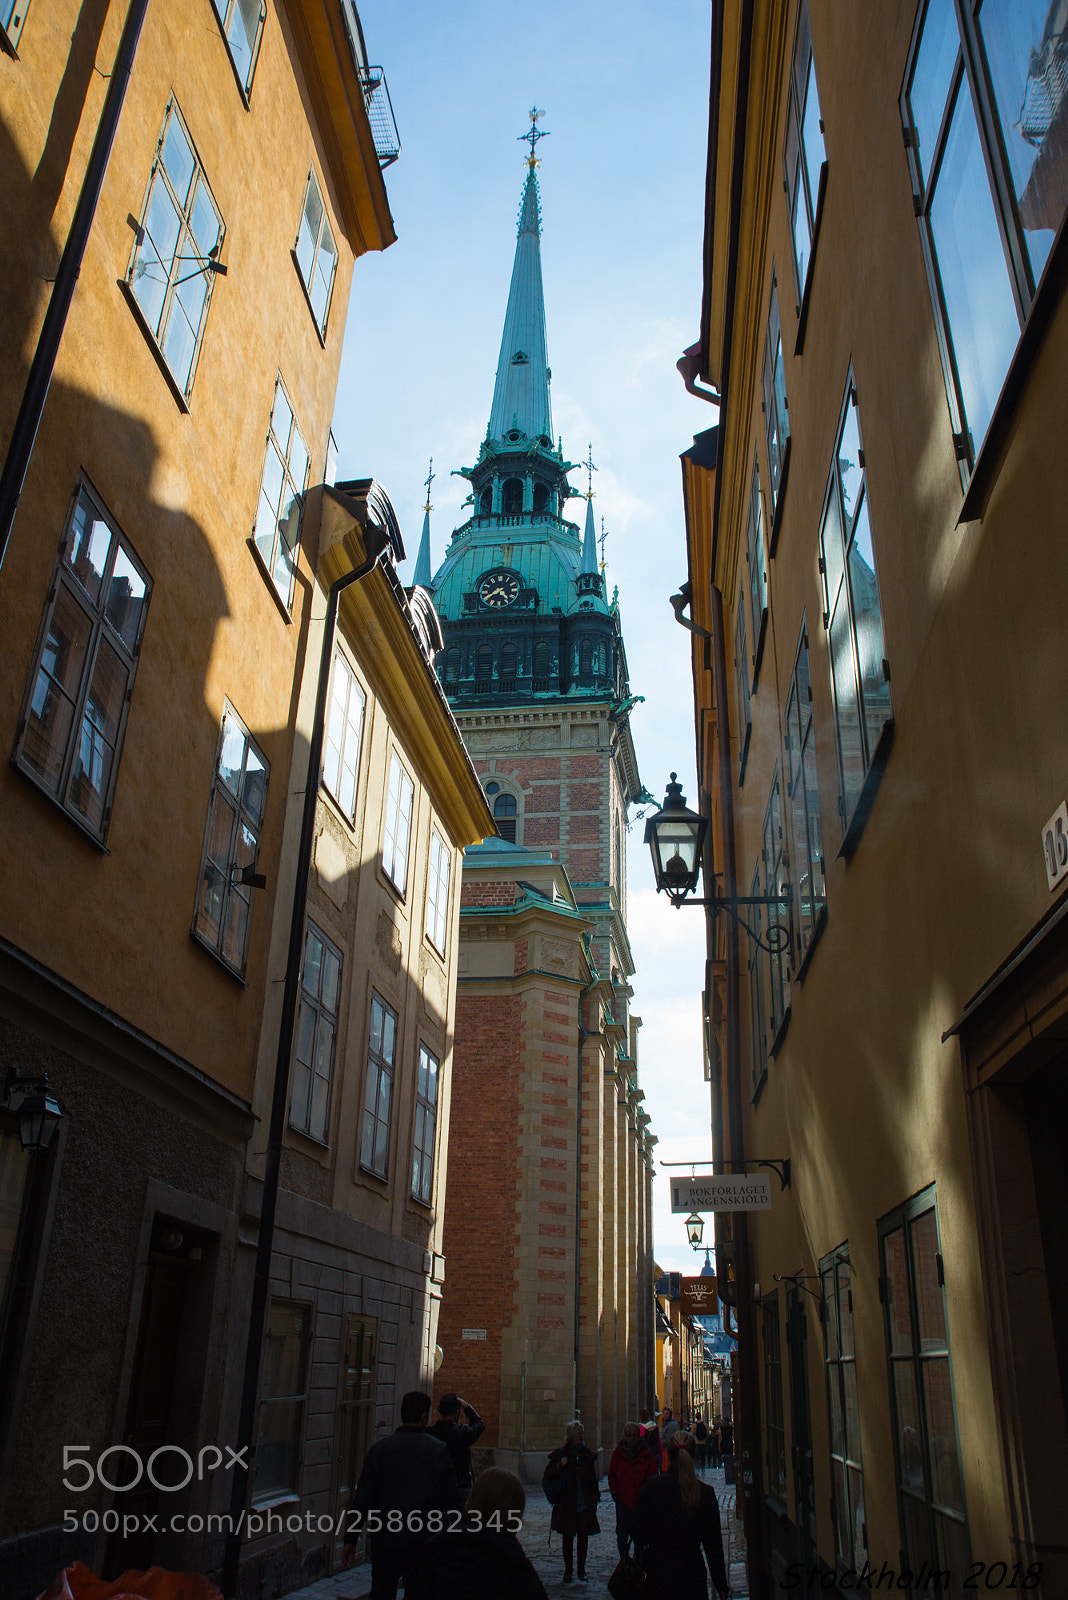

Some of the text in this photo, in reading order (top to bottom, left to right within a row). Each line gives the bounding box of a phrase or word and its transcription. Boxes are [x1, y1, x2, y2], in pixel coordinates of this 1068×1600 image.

[1046, 818, 1068, 876] 16
[673, 1188, 768, 1207] LANGENSKIÖLD
[689, 1185, 768, 1196] BOKFÖRLAGET
